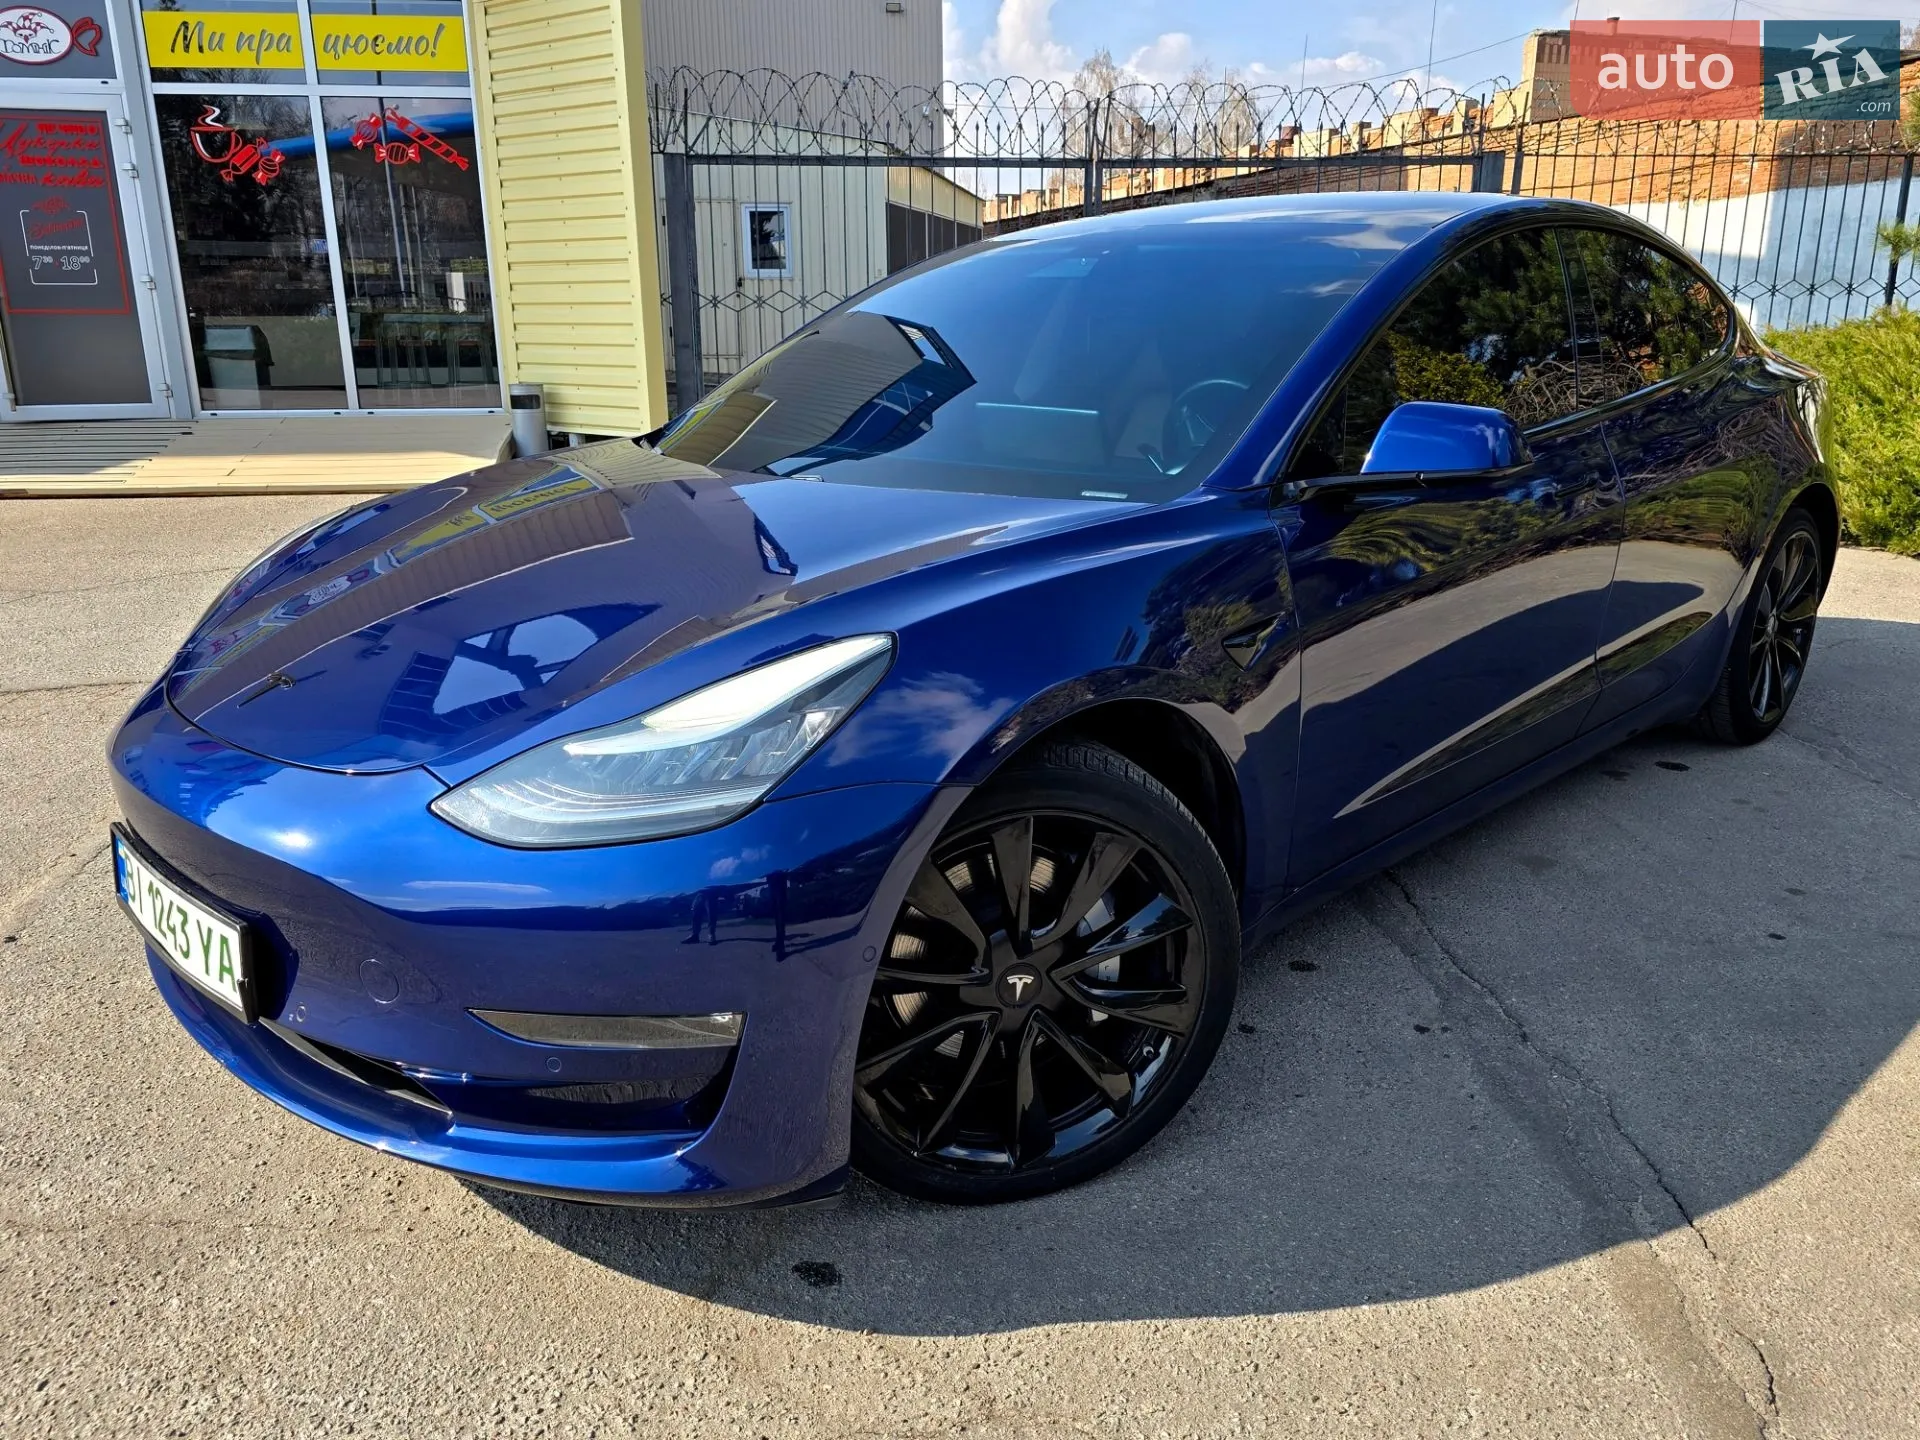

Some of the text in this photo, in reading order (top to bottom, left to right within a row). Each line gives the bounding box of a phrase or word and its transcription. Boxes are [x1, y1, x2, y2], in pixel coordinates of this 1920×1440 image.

[170, 20, 446, 65] Ми пра цюємо!
[148, 880, 190, 960] 1243
[196, 919, 237, 993] YA
